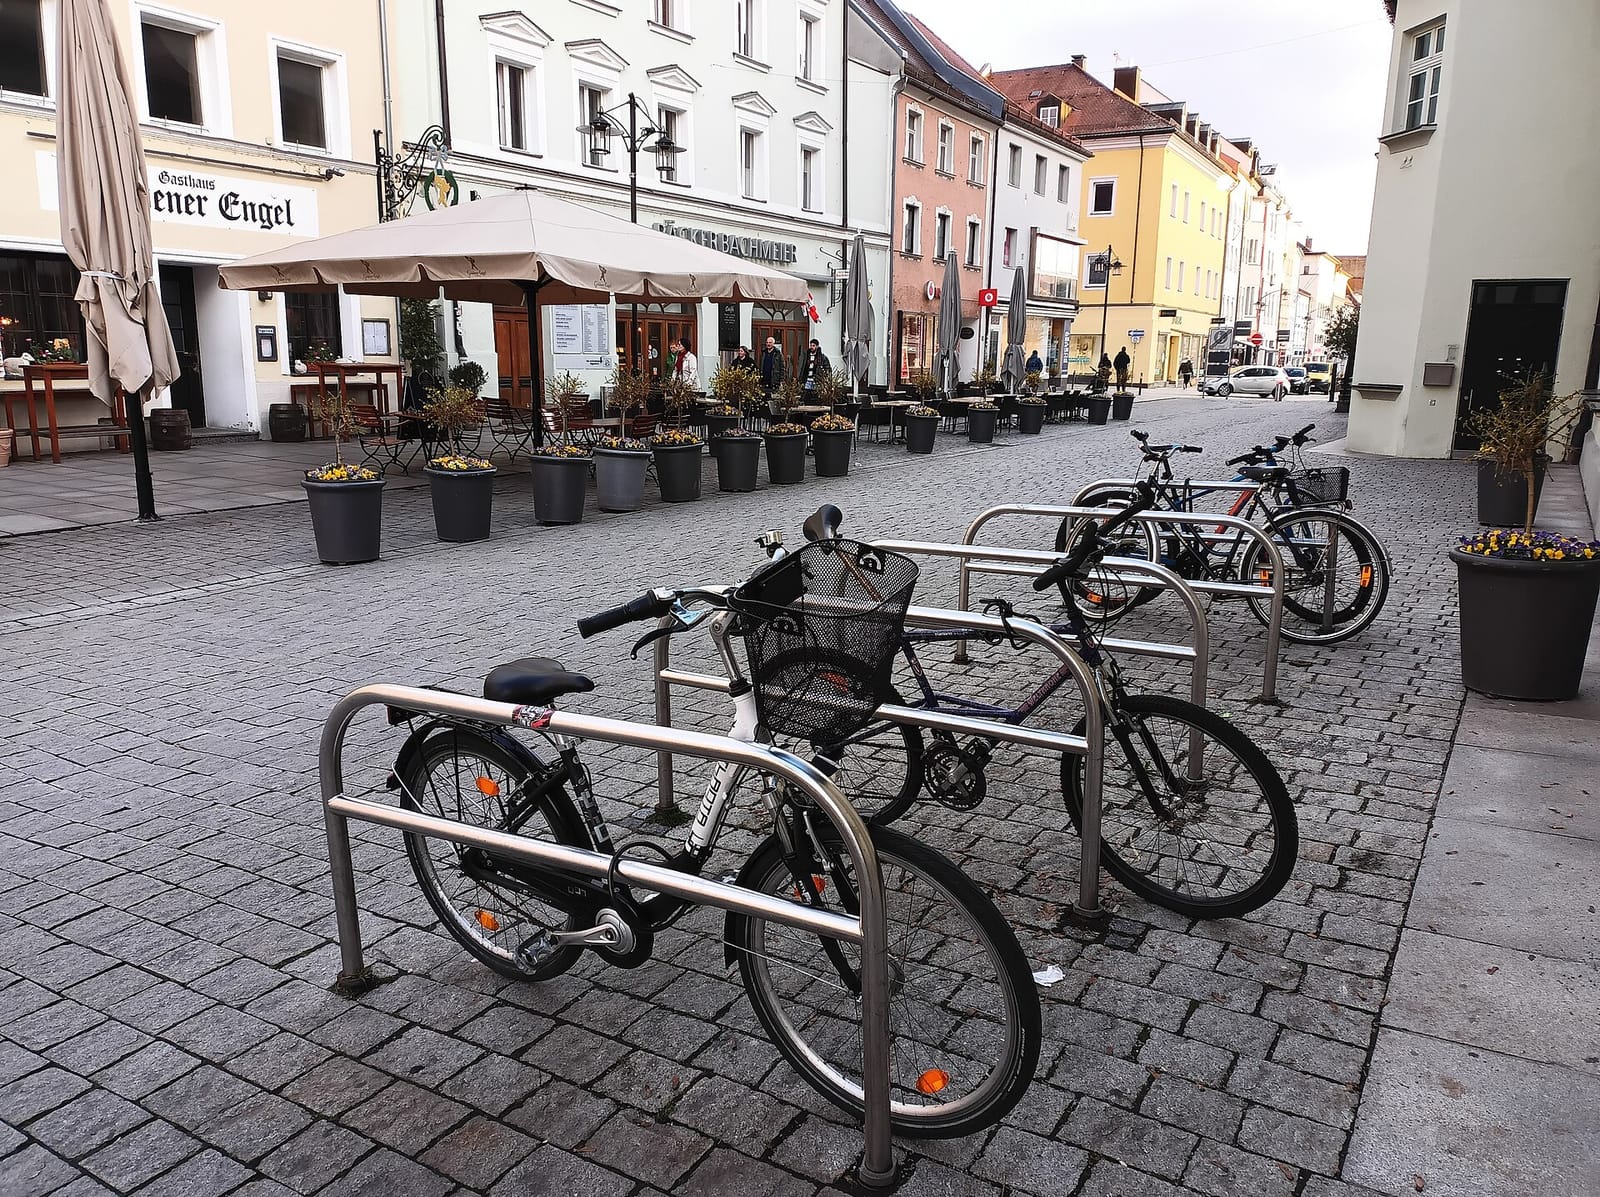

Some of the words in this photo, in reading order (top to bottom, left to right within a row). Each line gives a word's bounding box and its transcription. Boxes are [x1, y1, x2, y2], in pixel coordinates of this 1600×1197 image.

[158, 170, 216, 191] Gasthaus
[153, 189, 209, 217] ener
[218, 191, 295, 230] Engel
[718, 233, 798, 263] BACHMEIER
